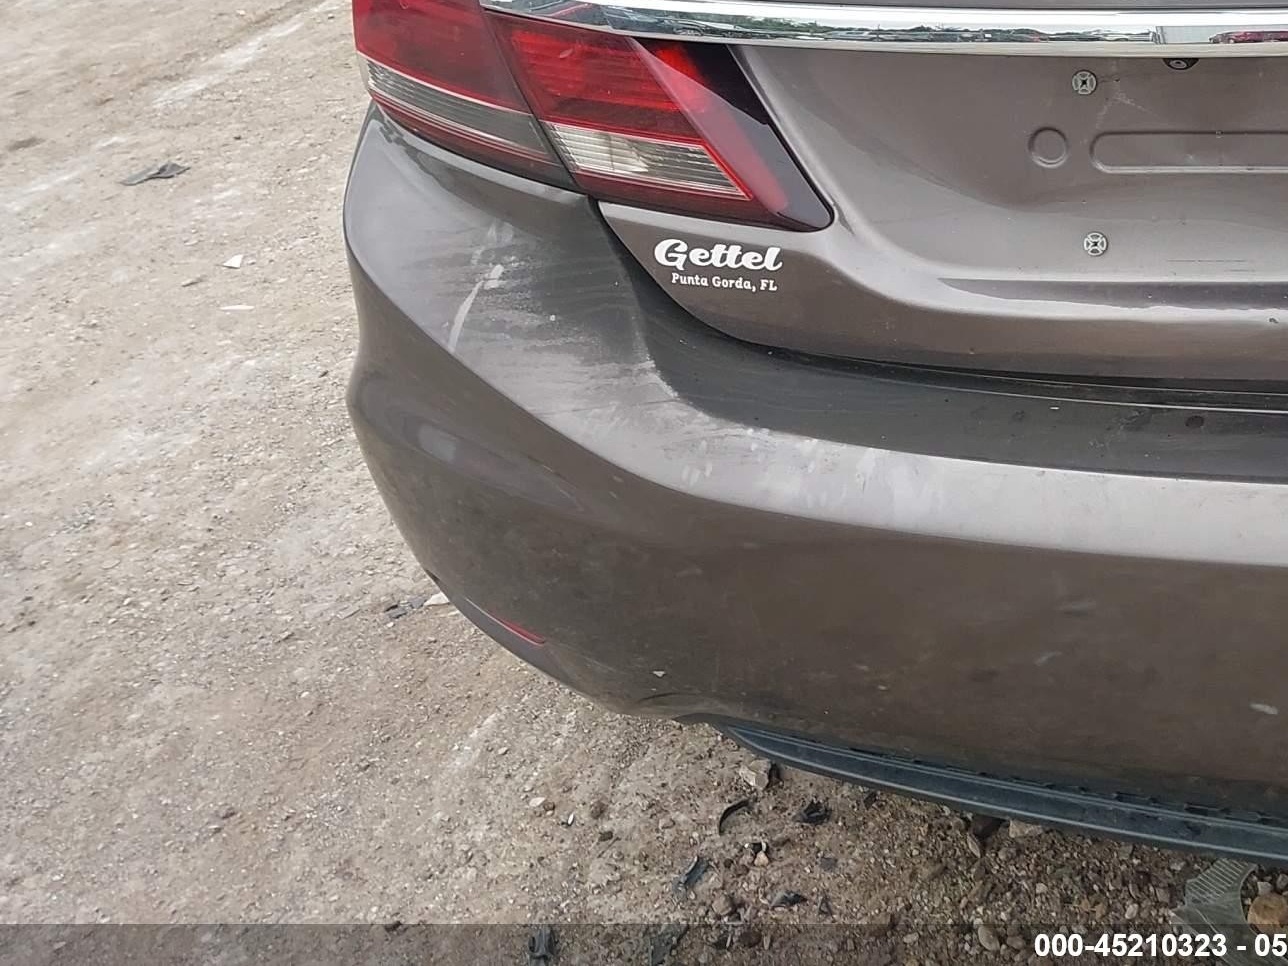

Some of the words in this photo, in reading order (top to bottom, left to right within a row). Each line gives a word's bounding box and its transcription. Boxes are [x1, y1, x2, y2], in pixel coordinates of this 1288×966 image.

[654, 238, 783, 271] Gettel
[671, 272, 709, 287] Punta
[711, 276, 756, 292] Gorda,
[759, 279, 778, 292] FL
